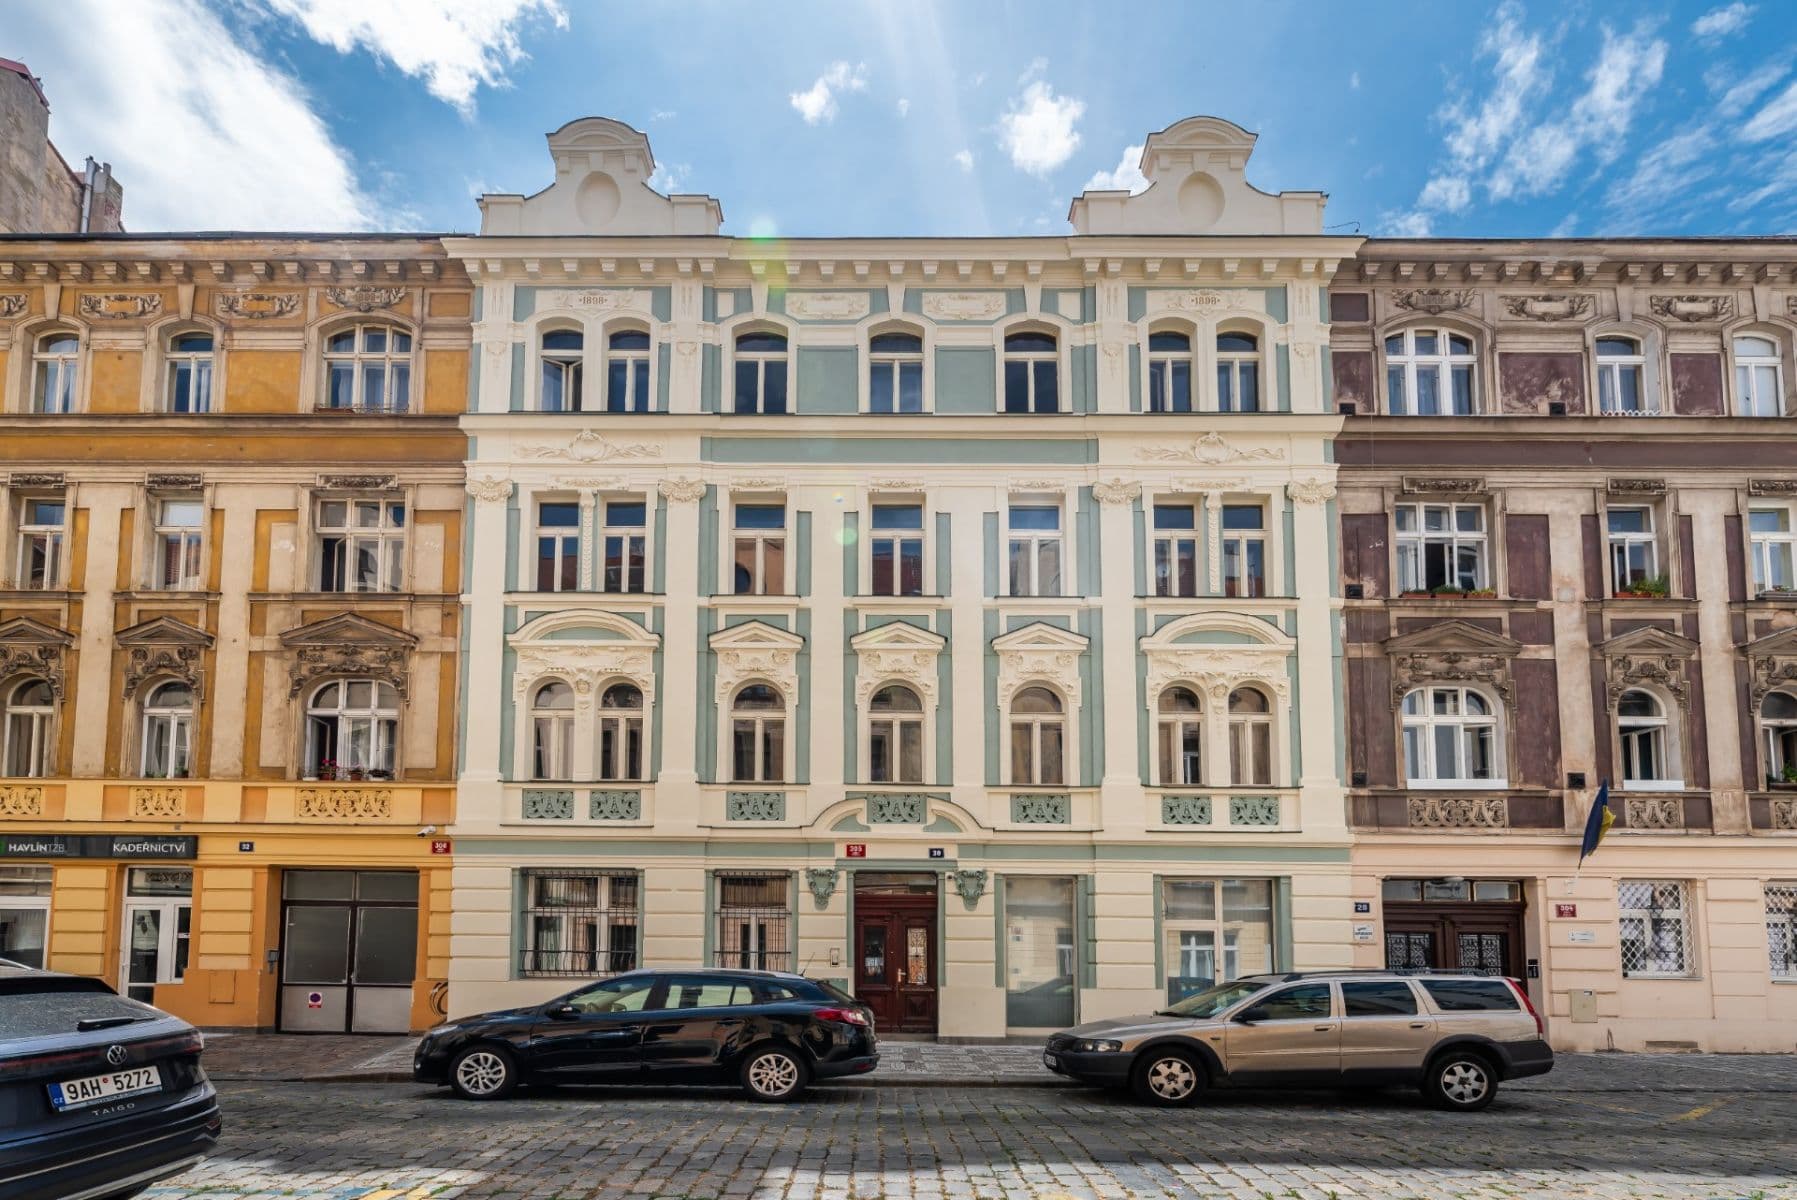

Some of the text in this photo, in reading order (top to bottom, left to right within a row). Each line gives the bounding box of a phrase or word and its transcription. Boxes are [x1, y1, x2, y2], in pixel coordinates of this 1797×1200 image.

[113, 841, 186, 853] KADEŘNICTVÍ
[66, 1079, 102, 1100] 9AH
[112, 1070, 154, 1091] 5272
[53, 1097, 64, 1105] CZ
[91, 1103, 135, 1116] TAIGO
